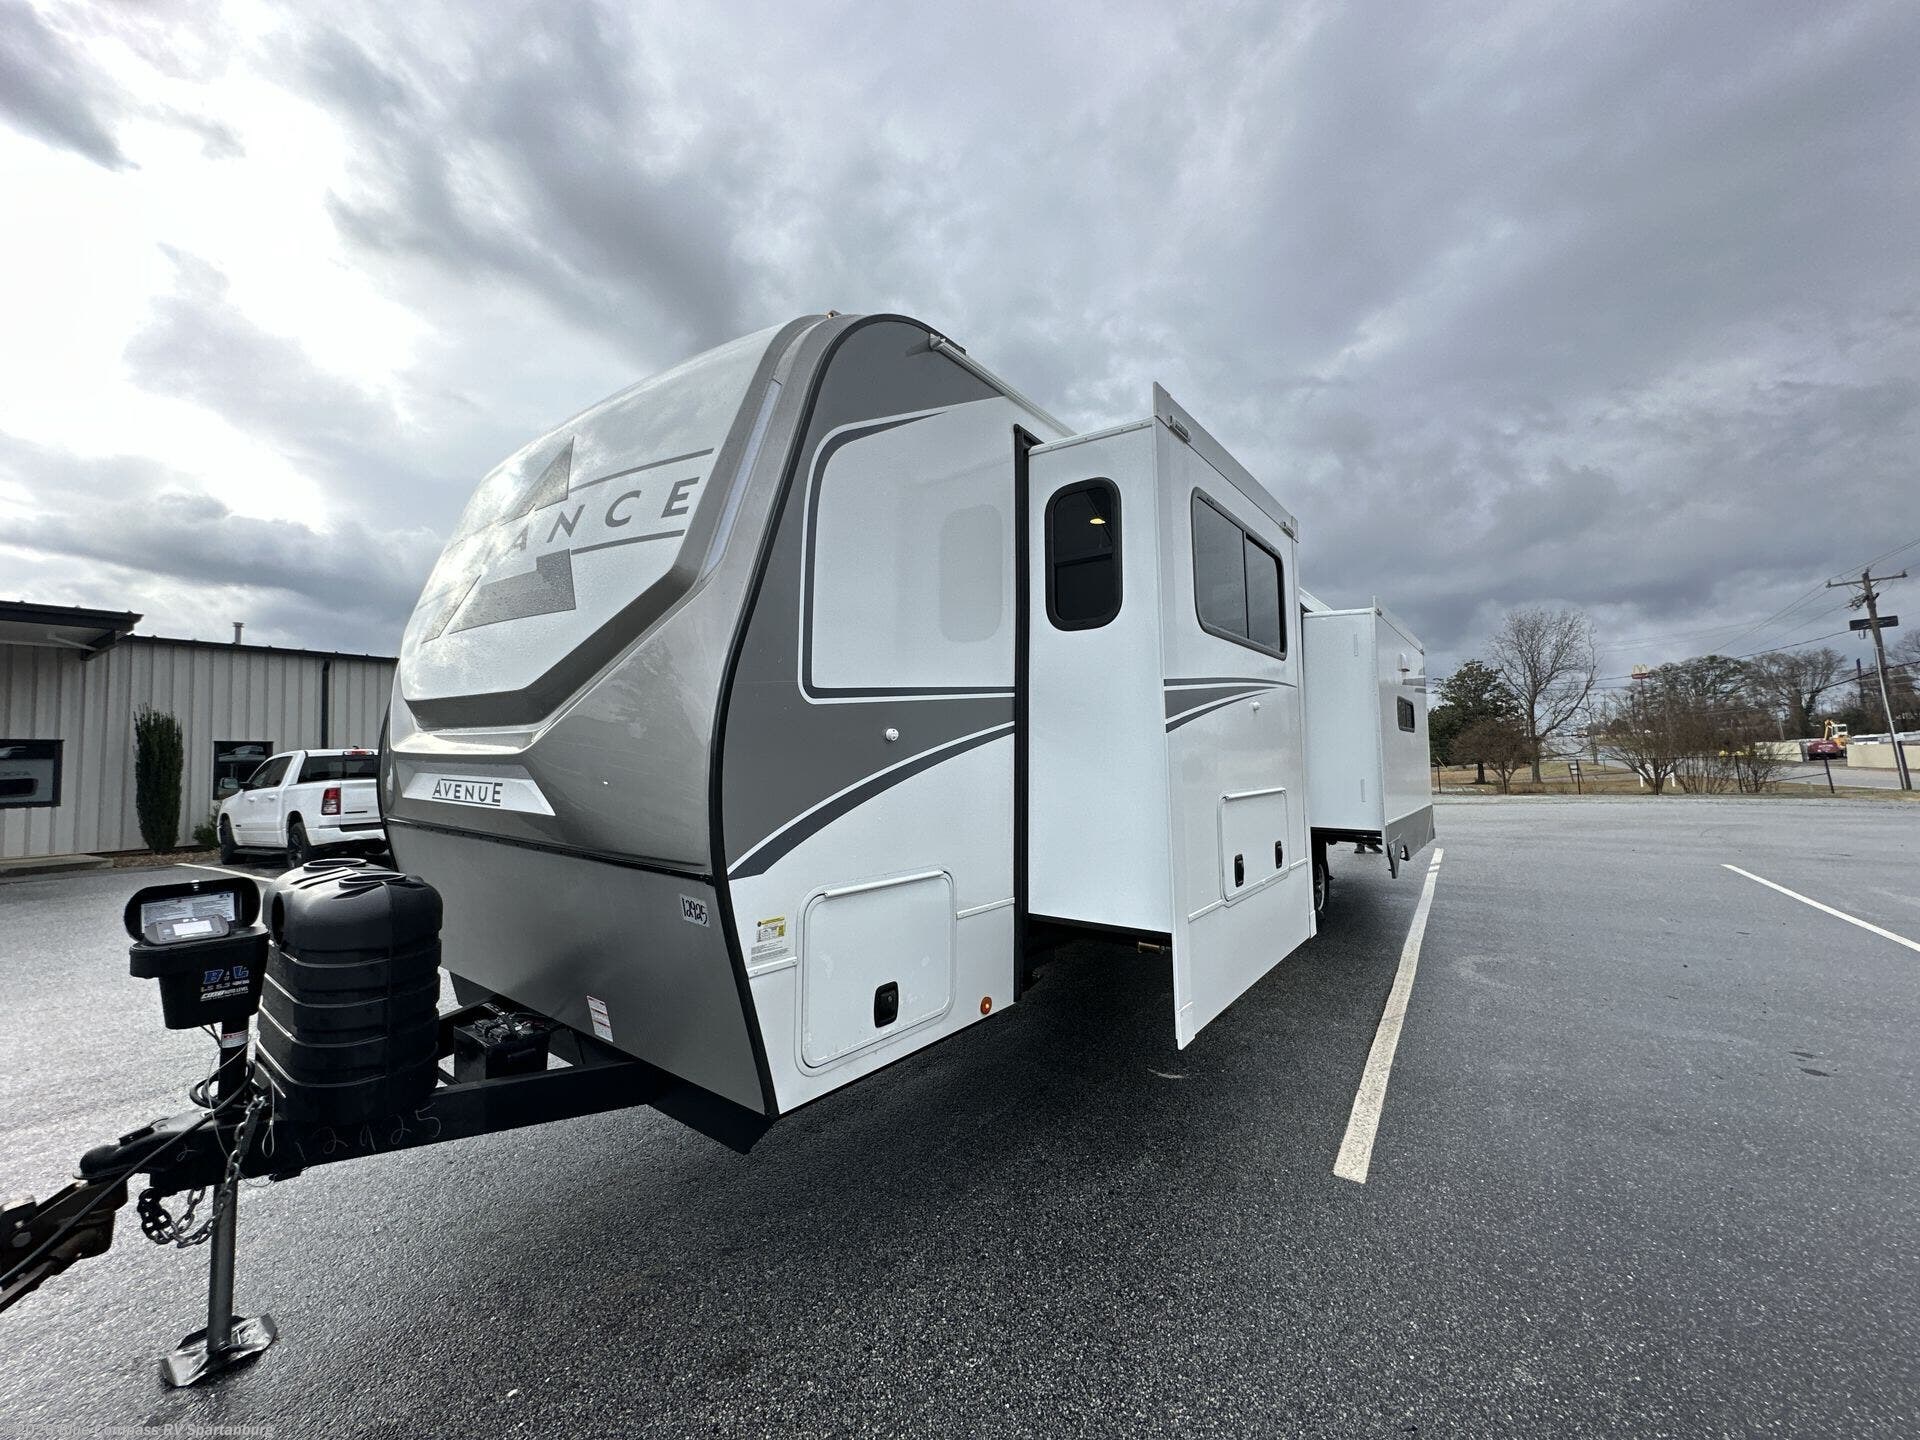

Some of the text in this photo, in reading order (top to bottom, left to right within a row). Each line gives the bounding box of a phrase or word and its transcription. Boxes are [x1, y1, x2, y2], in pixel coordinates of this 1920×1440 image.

[484, 476, 701, 565] ANCE
[433, 779, 504, 803] AVENUE
[681, 897, 708, 925] 12925
